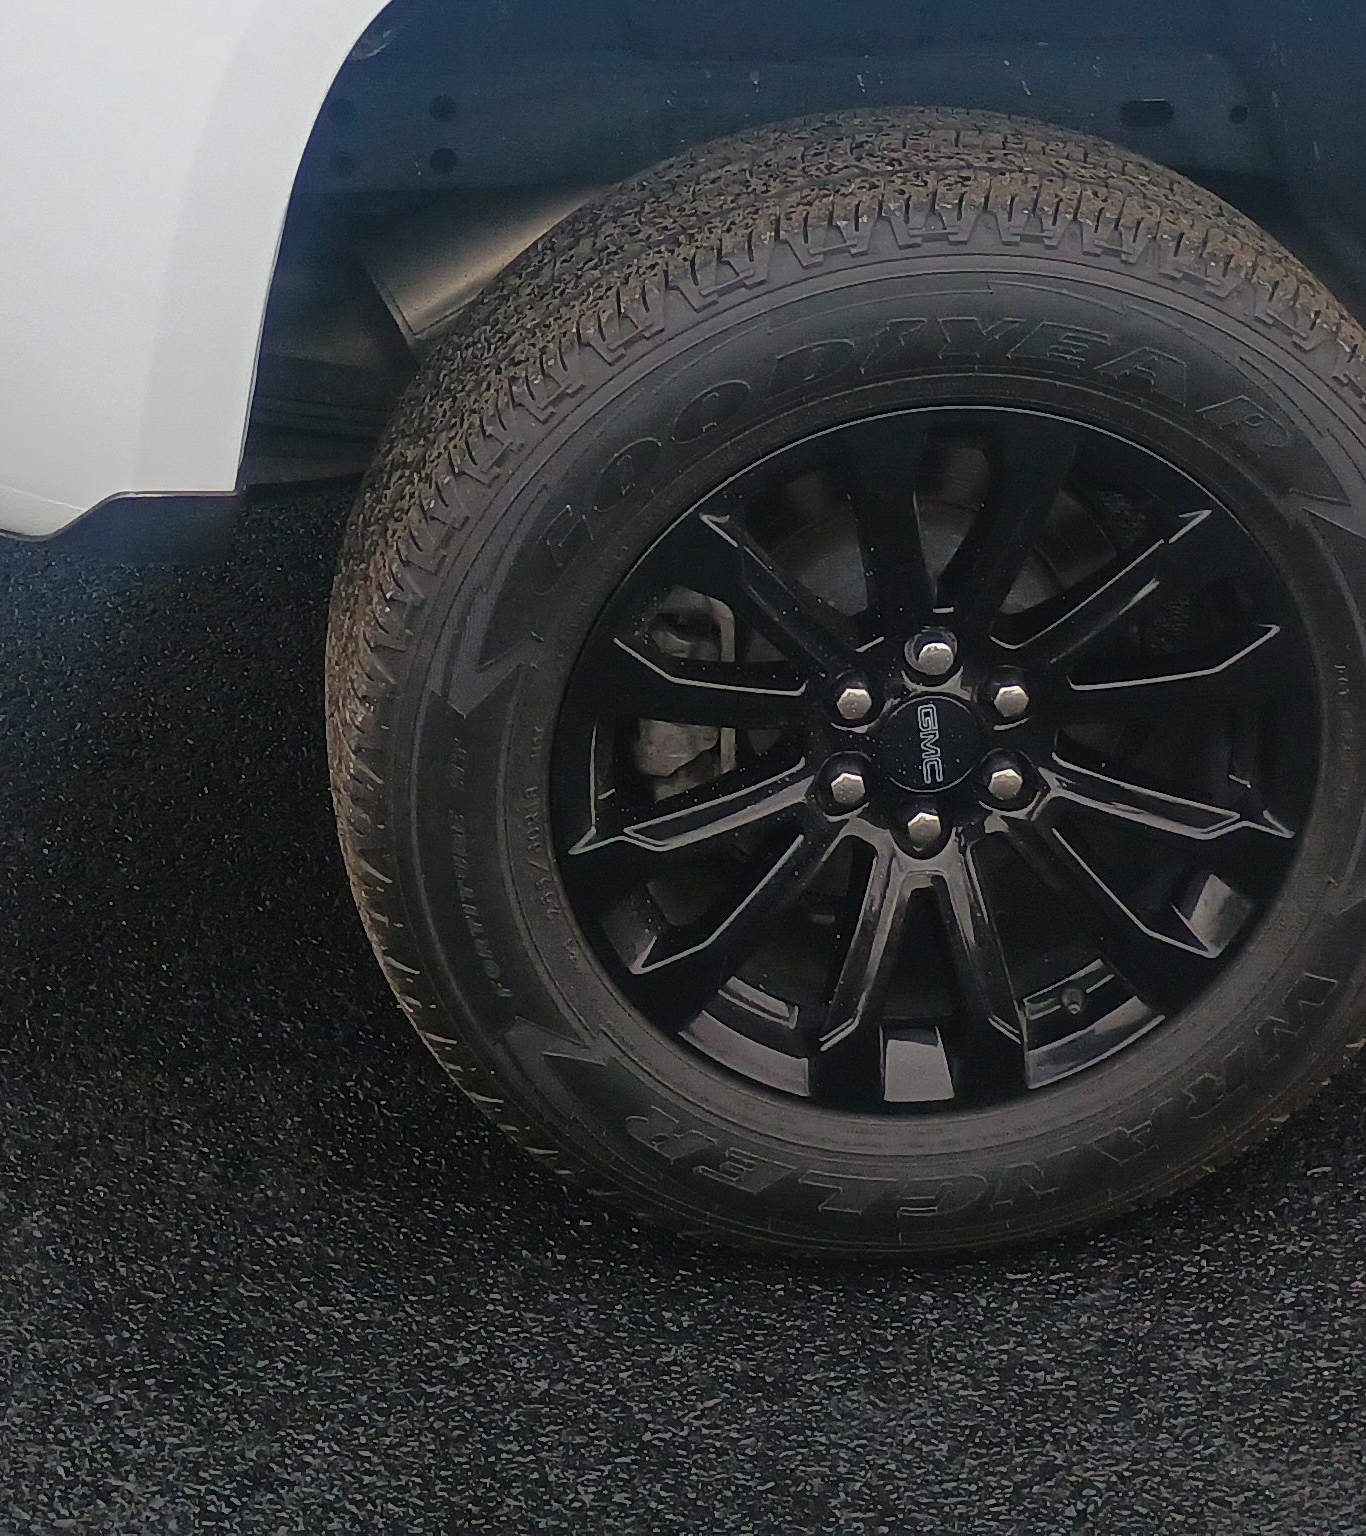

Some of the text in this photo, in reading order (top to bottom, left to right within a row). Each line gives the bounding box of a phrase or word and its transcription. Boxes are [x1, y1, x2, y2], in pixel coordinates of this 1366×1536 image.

[537, 313, 1297, 574] GOODYEAR
[917, 703, 943, 785] GMC
[623, 969, 1339, 1220] WRANGLER
